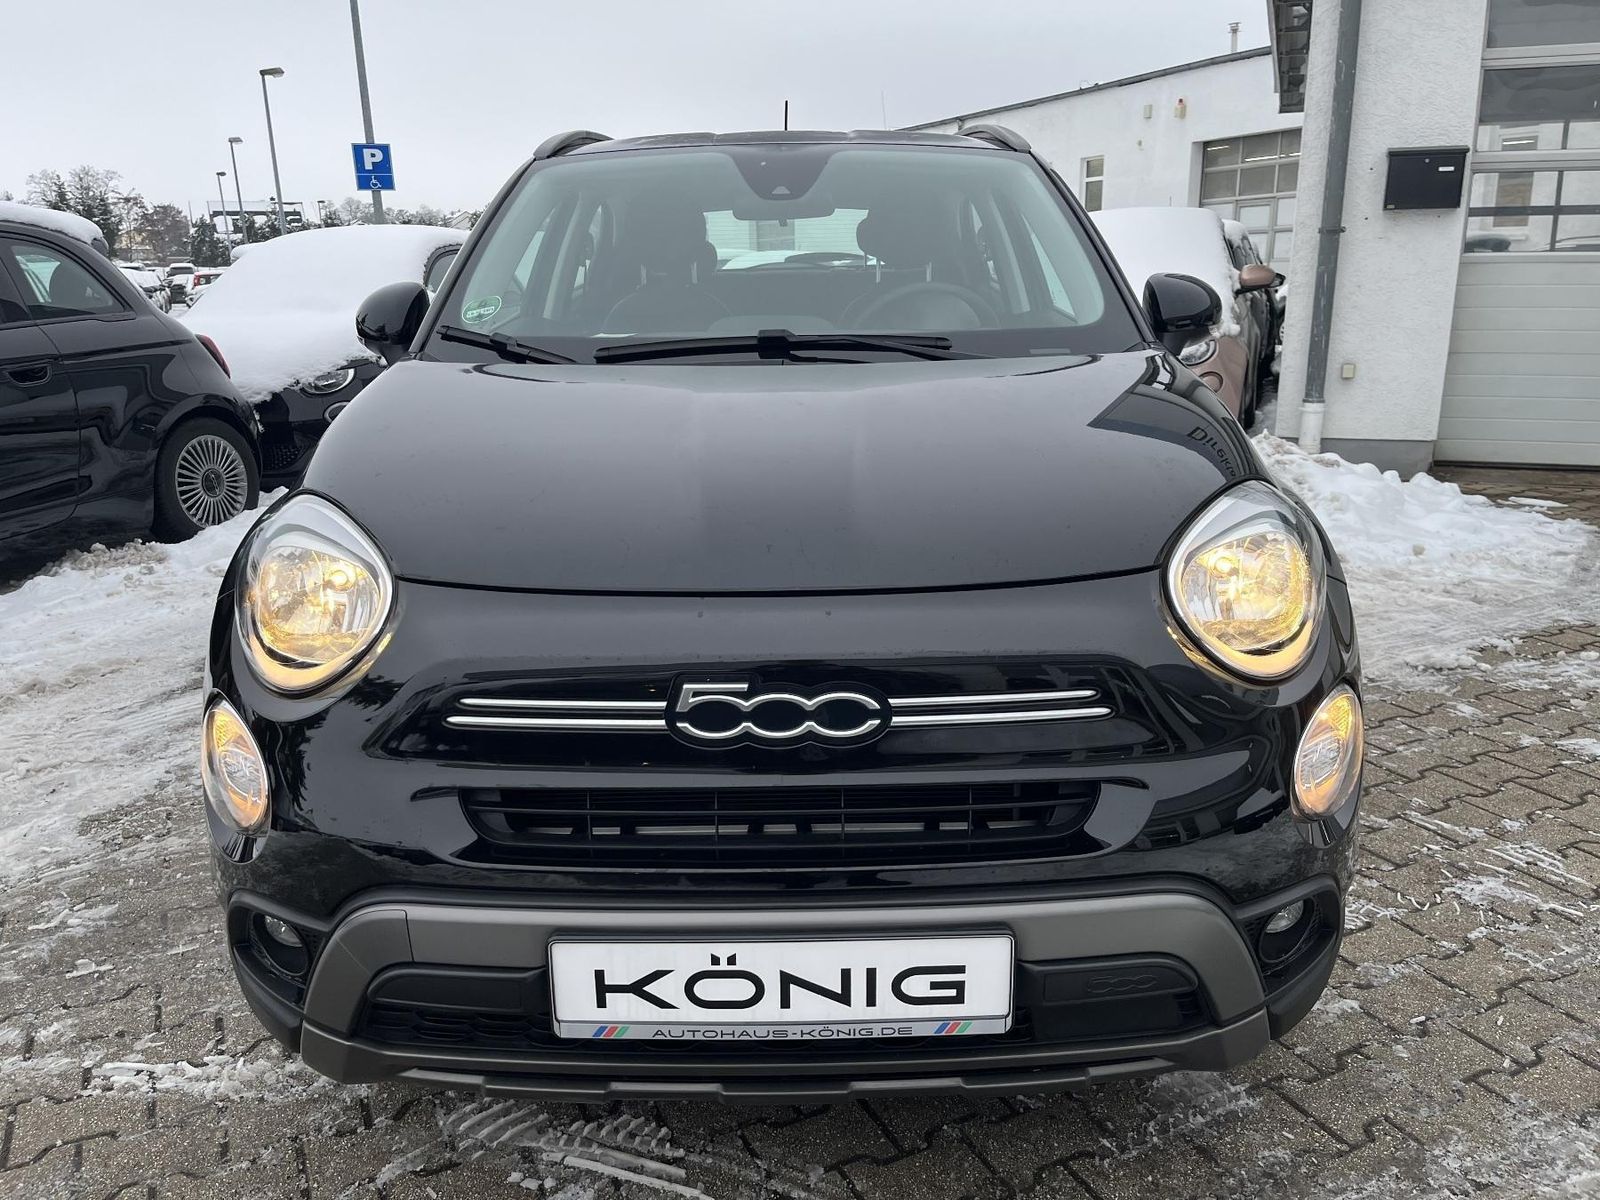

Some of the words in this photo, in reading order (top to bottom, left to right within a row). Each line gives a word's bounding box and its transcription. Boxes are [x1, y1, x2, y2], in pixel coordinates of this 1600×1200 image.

[363, 148, 383, 170] P
[676, 683, 881, 740] 500
[594, 952, 967, 1010] KÖNIG
[1087, 974, 1159, 994] 500
[652, 1026, 913, 1039] AUTOHAUS-KÖNIG.DE
